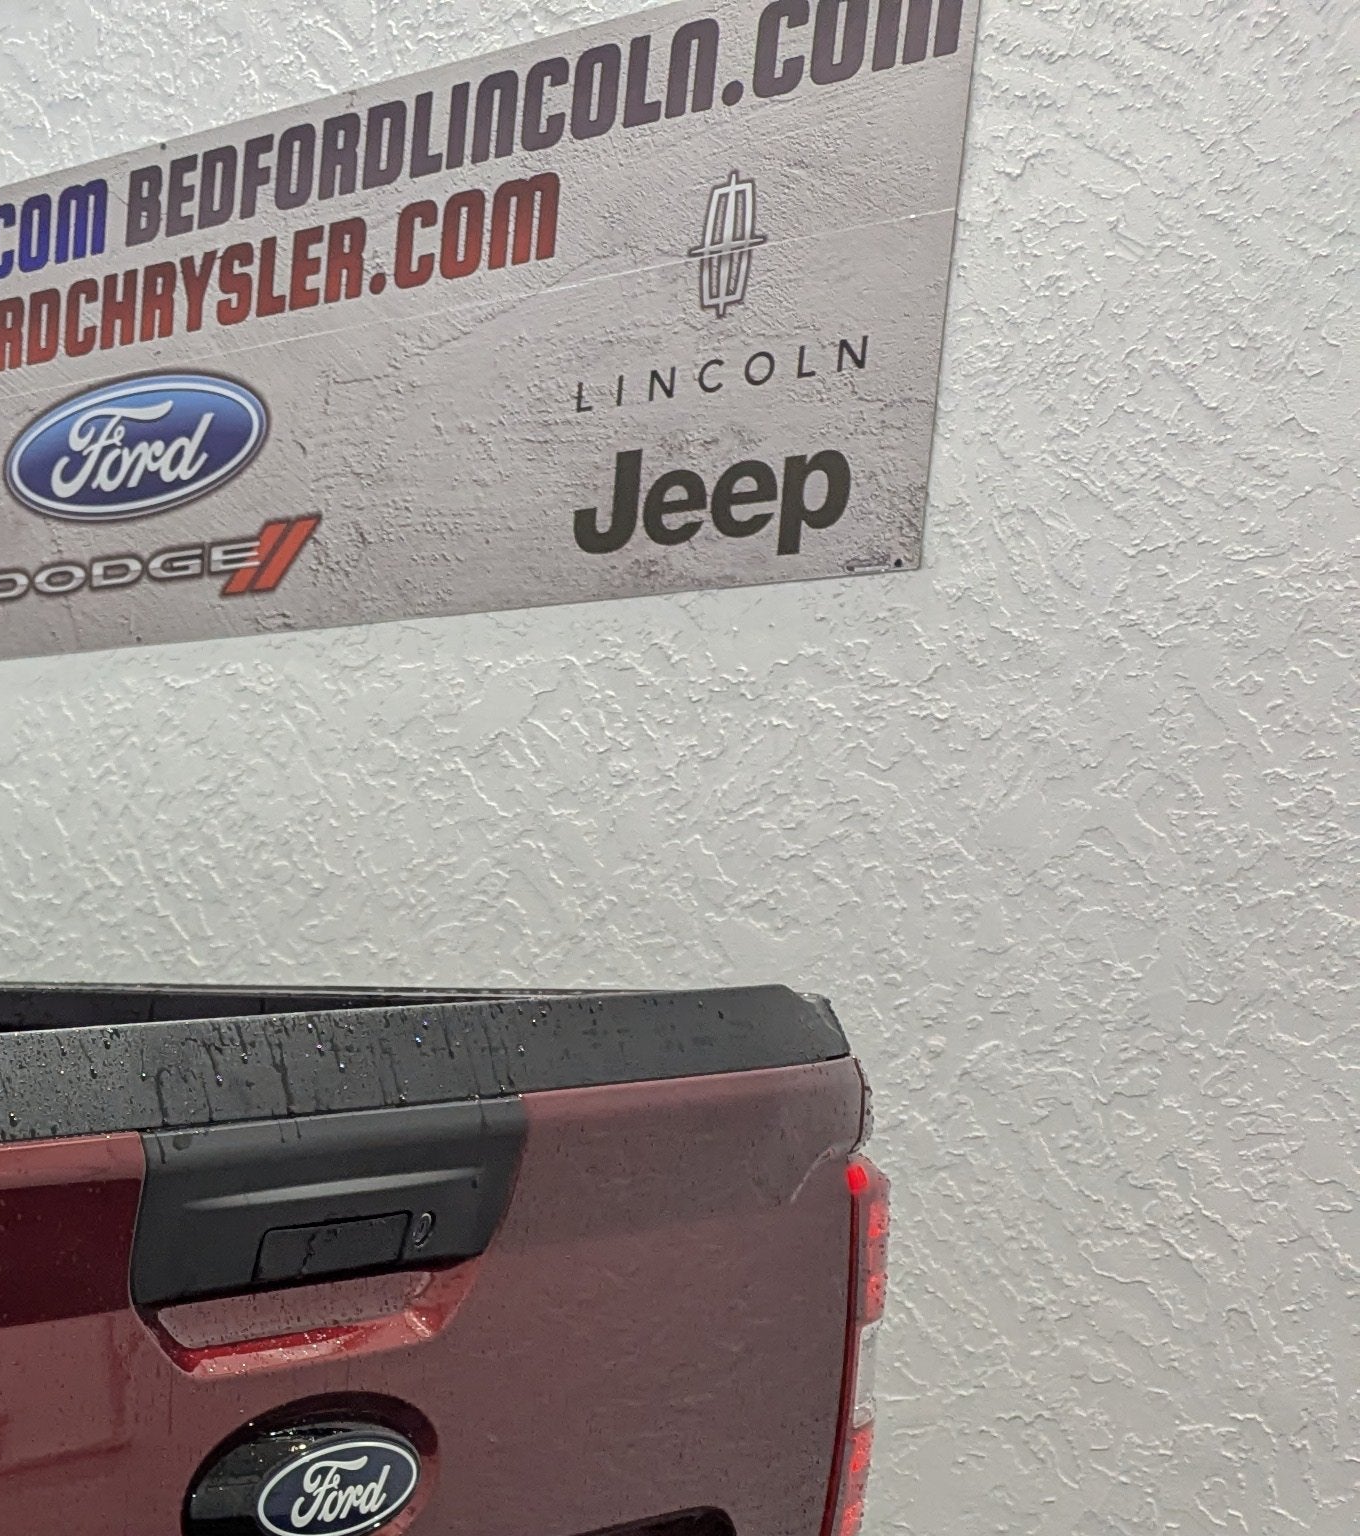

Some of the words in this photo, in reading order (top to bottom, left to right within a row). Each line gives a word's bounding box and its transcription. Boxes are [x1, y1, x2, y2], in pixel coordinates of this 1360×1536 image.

[575, 335, 870, 412] LINCOLN
[51, 402, 215, 498] Ford
[573, 450, 850, 556] Jeep
[291, 1455, 391, 1528] Ford
